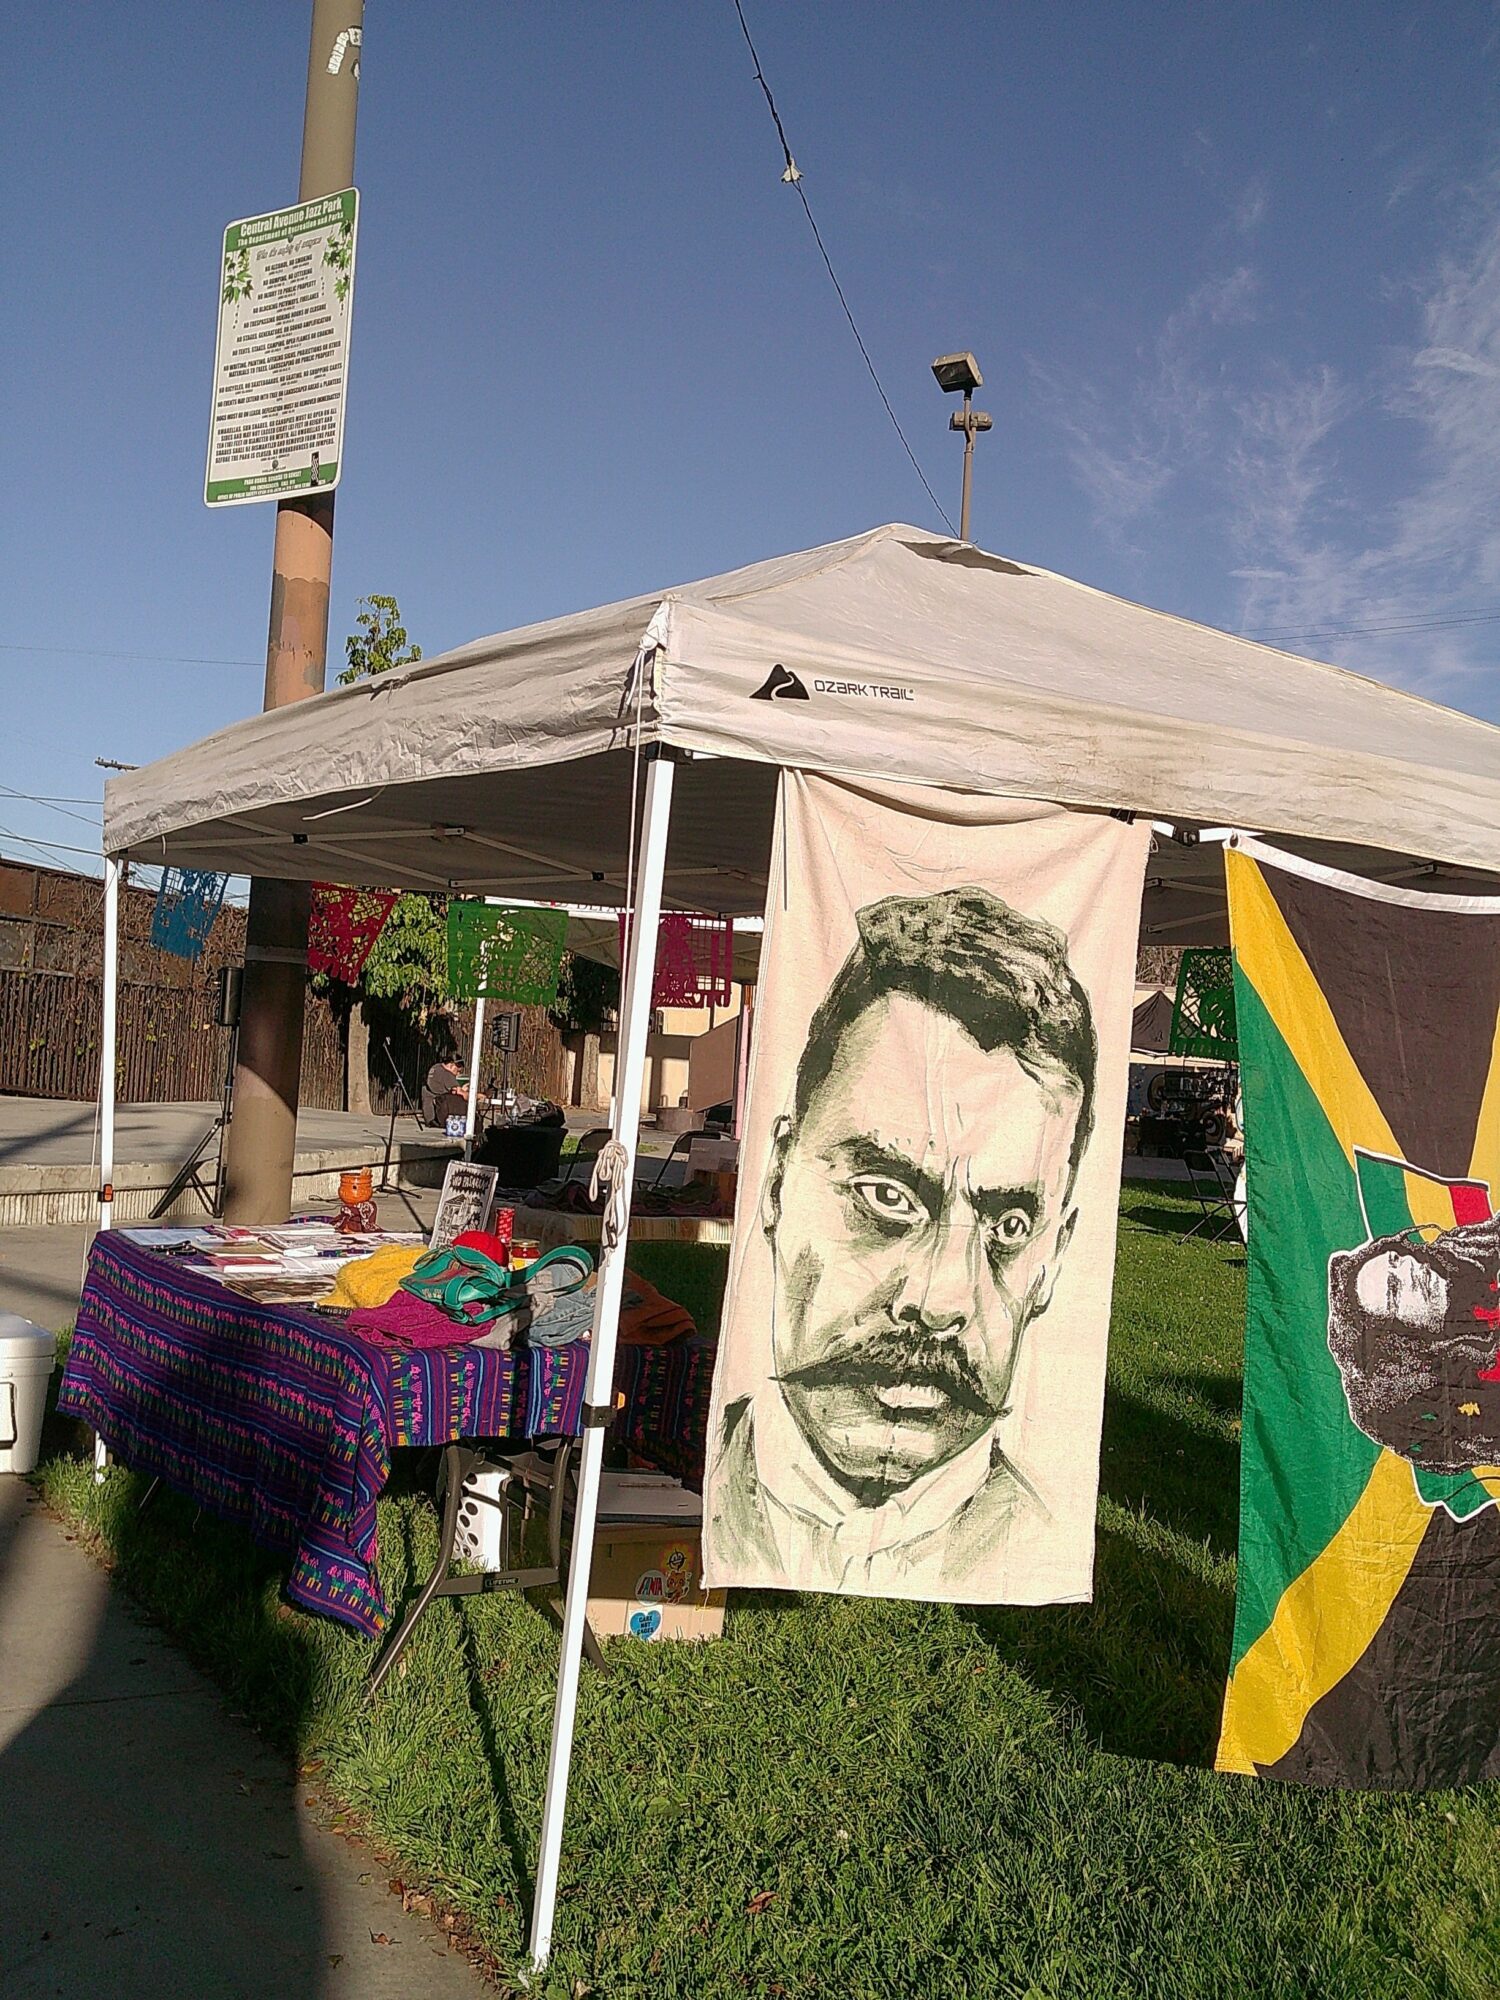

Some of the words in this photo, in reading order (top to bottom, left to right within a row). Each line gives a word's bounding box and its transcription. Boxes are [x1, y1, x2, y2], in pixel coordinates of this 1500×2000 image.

[238, 239, 248, 247] The
[249, 230, 281, 245] Department
[281, 228, 287, 236] of
[288, 220, 317, 234] Recreation
[318, 215, 327, 225] and
[328, 212, 344, 222] Parks
[241, 217, 273, 237] Central
[274, 210, 304, 229] Avenue
[305, 205, 322, 220] Jazz
[323, 197, 342, 214] Park
[253, 307, 258, 315] NO
[814, 679, 869, 696] OZARK
